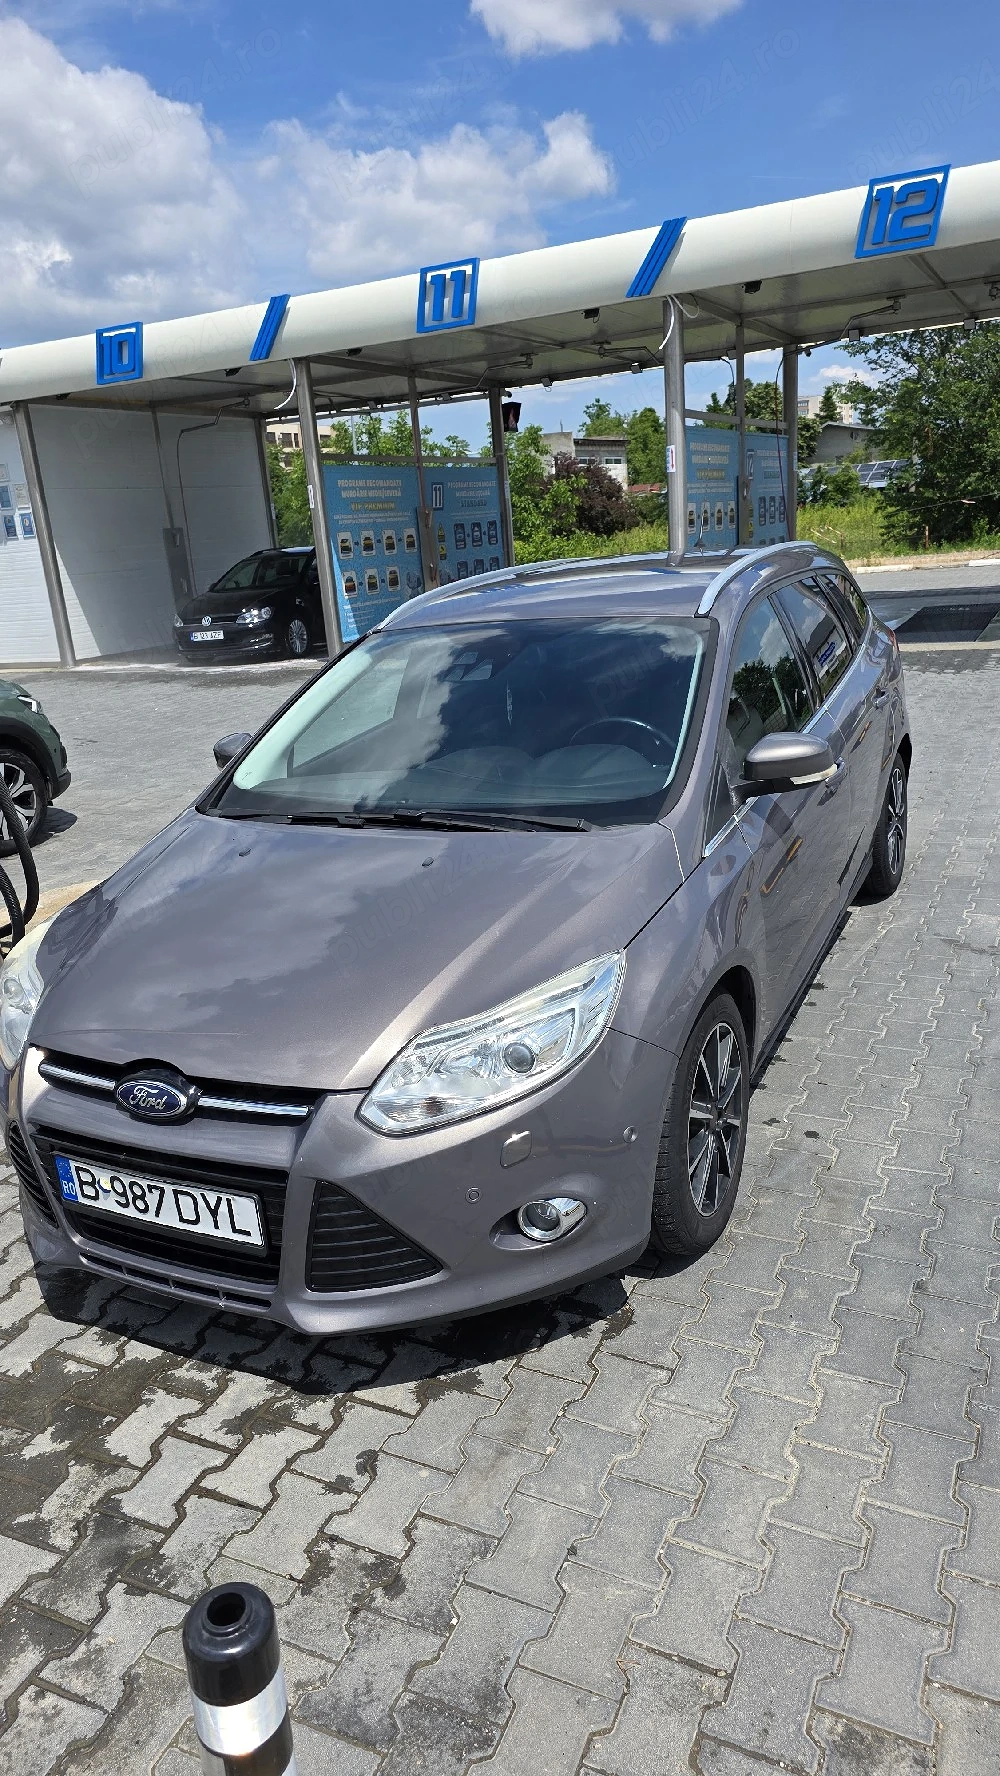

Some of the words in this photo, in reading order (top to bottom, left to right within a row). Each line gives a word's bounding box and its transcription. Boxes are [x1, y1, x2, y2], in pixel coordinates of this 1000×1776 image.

[872, 178, 939, 246] 12
[430, 270, 466, 321] 11
[101, 331, 136, 376] 10
[129, 1085, 168, 1110] Ford
[62, 1180, 76, 1195] RO
[74, 1164, 100, 1202] B
[109, 1175, 166, 1218] 987
[172, 1188, 252, 1237] DYL
